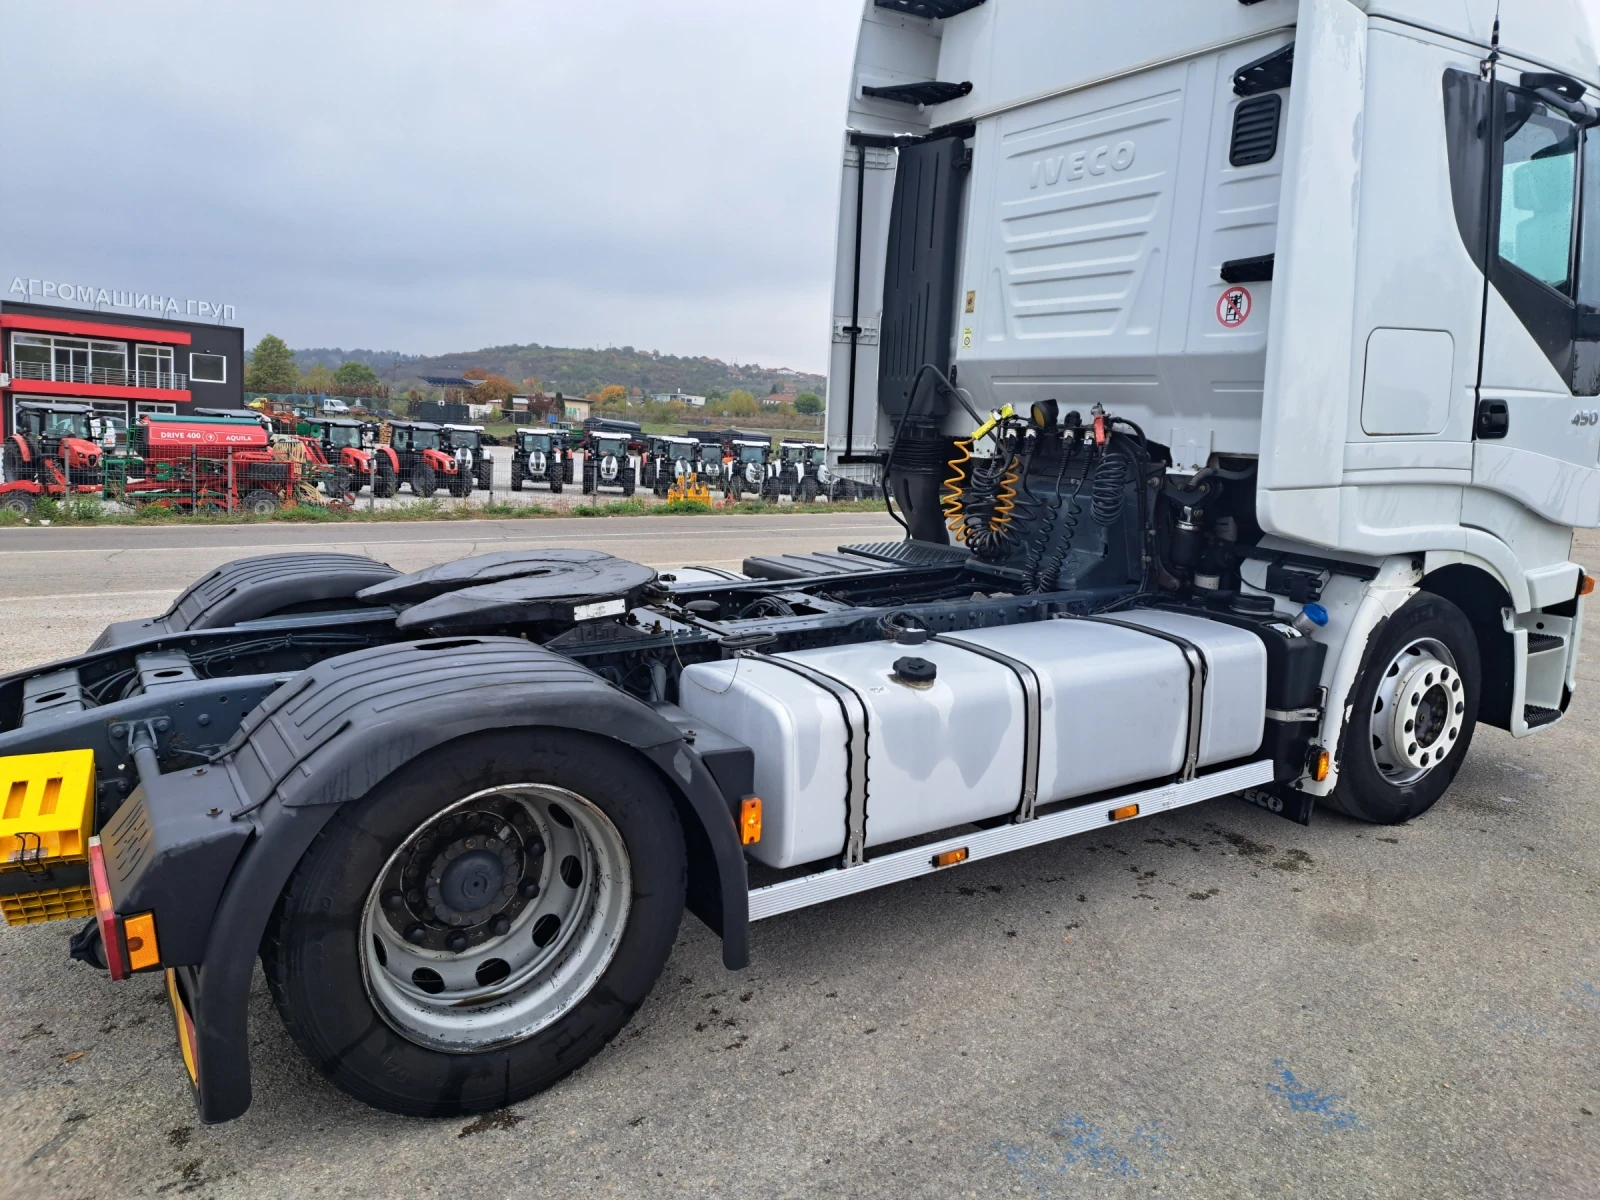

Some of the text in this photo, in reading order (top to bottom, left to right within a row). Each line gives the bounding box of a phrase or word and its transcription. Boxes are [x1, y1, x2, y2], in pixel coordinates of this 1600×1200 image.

[1029, 140, 1136, 190] IVECO
[9, 276, 236, 320] АГРОМАШИНА ГРУП
[1570, 409, 1599, 427] 450
[160, 431, 185, 439] DRIVE
[225, 434, 252, 442] AQUILA
[1232, 787, 1284, 813] ECO
